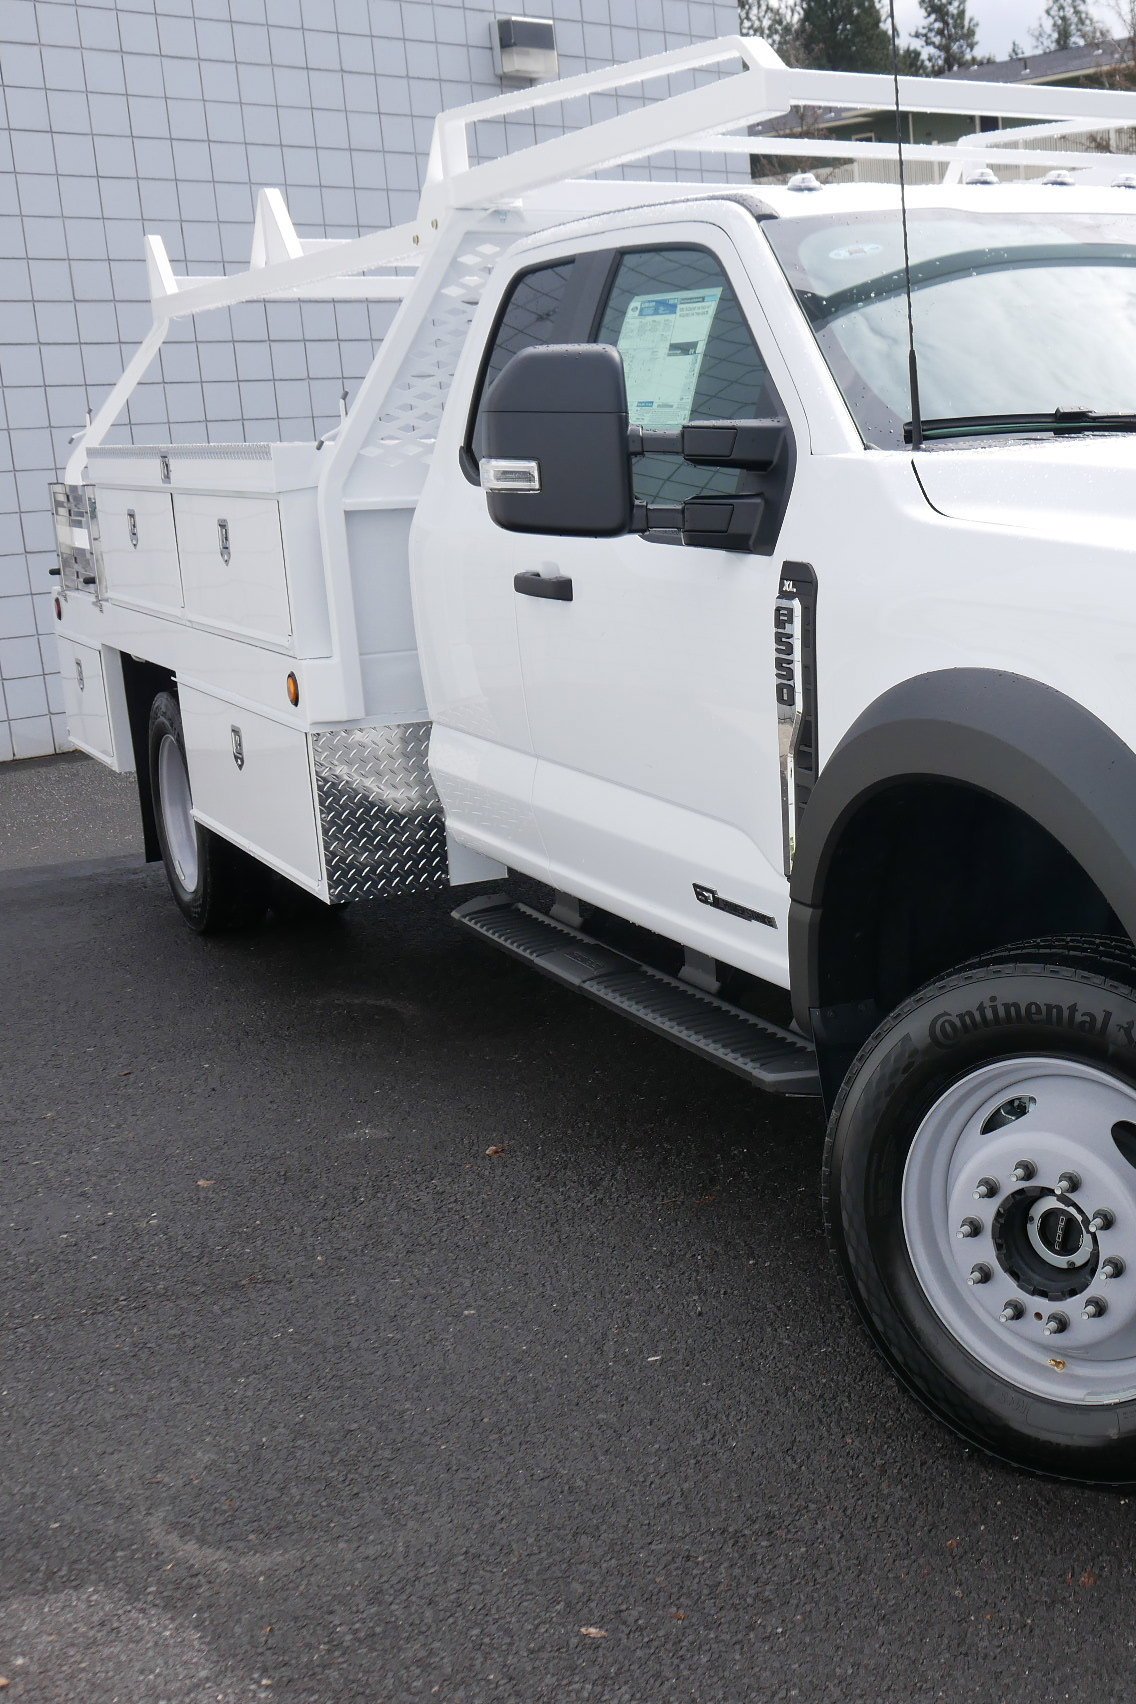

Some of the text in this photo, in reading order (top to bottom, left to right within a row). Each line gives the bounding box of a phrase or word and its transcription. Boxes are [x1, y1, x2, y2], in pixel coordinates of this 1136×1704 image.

[782, 580, 796, 592] XL
[928, 996, 1113, 1049] Continental
[1054, 1215, 1066, 1251] FORD
